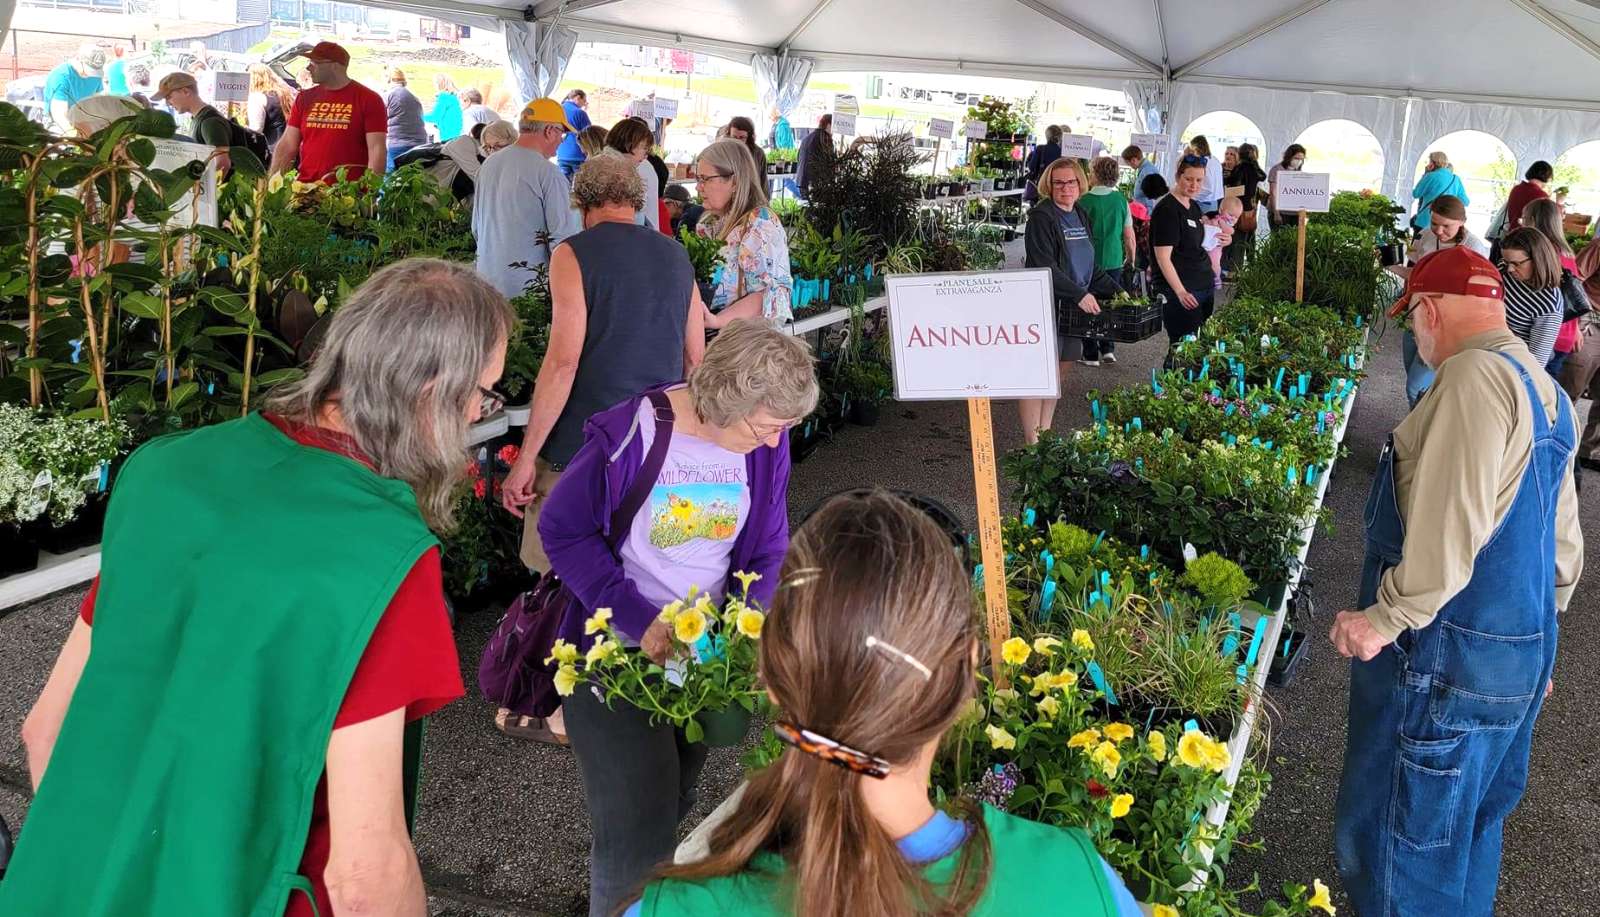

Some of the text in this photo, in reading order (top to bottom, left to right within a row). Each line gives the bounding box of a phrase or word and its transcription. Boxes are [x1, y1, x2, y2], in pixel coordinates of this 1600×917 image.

[311, 102, 353, 113] IOWA
[307, 111, 352, 123] STATE
[306, 121, 349, 130] WRESTLING
[1281, 186, 1325, 196] ANNUALS
[943, 278, 993, 287] PLANT SALE
[935, 286, 1003, 296] EXTRAVAGANZA
[907, 323, 1041, 348] ANNUALS
[657, 468, 742, 484] WILDFLOWER
